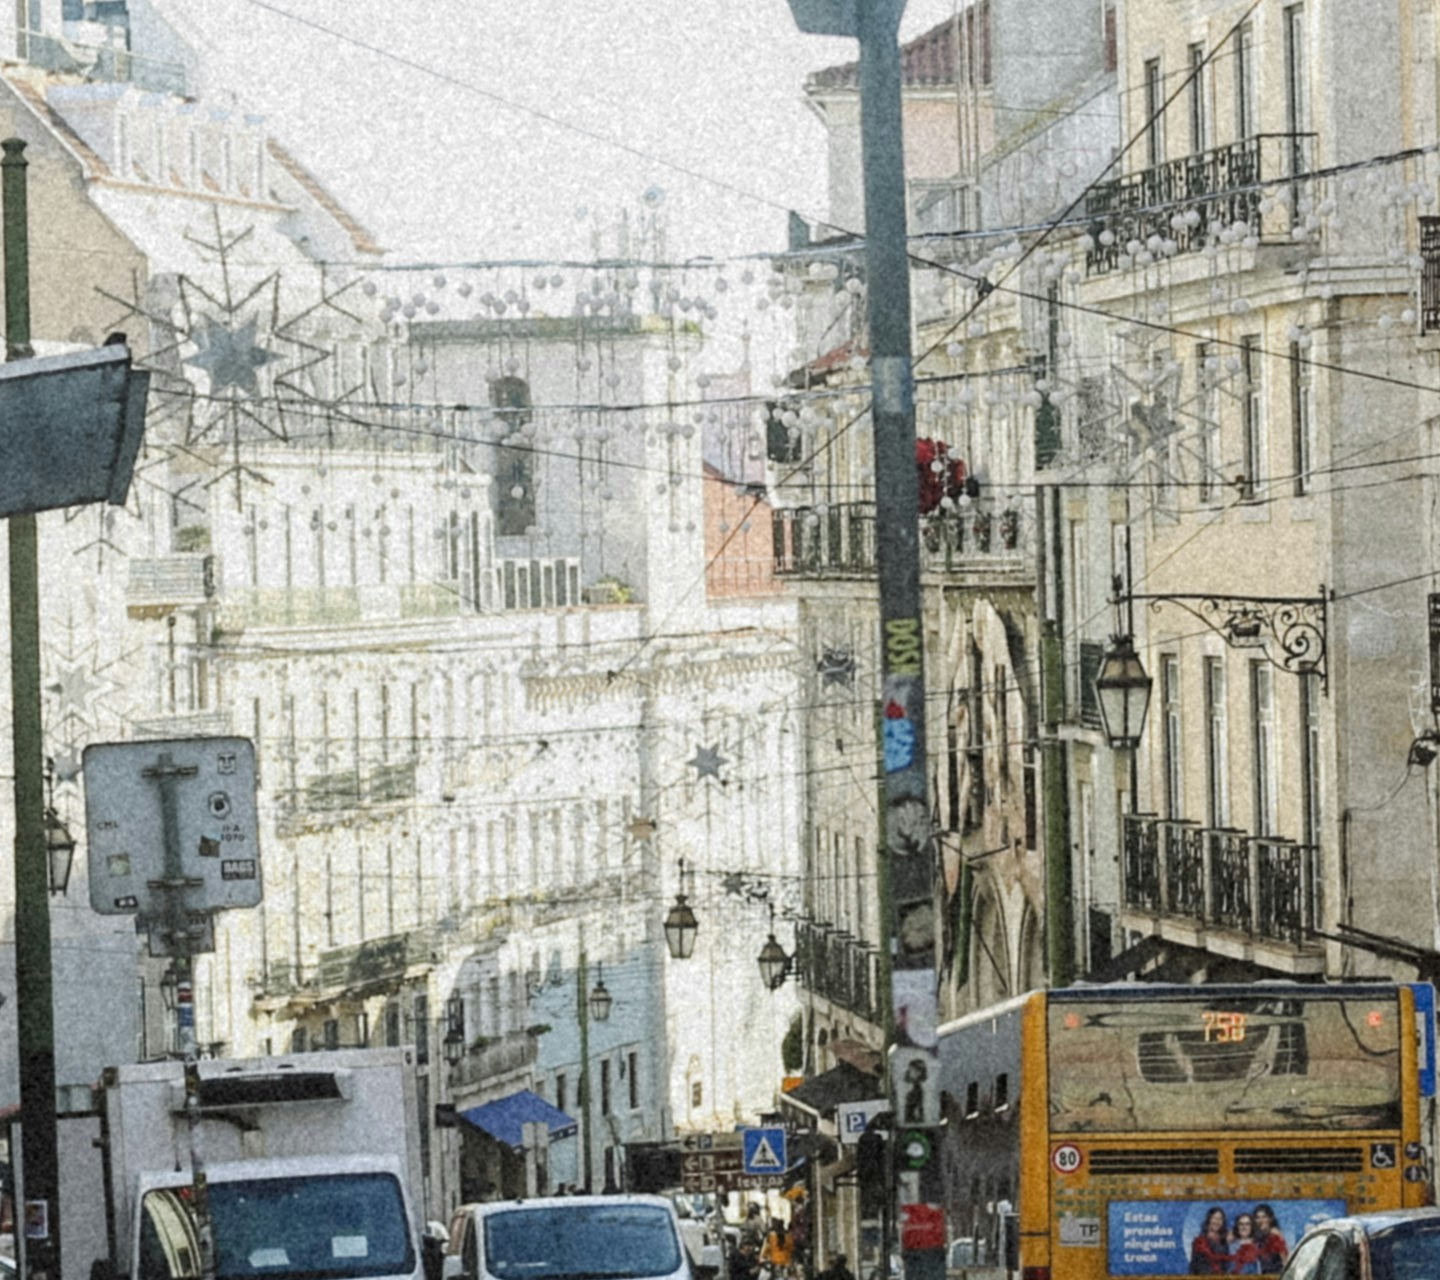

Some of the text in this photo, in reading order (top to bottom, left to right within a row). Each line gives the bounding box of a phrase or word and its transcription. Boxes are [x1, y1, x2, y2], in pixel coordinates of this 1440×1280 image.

[1059, 1151, 1077, 1166] 80
[1124, 1212, 1158, 1222] Estas
[1079, 1223, 1099, 1237] TP
[1124, 1225, 1173, 1239] prendas
[1124, 1237, 1176, 1252] ninguém
[1124, 1253, 1158, 1262] troca
